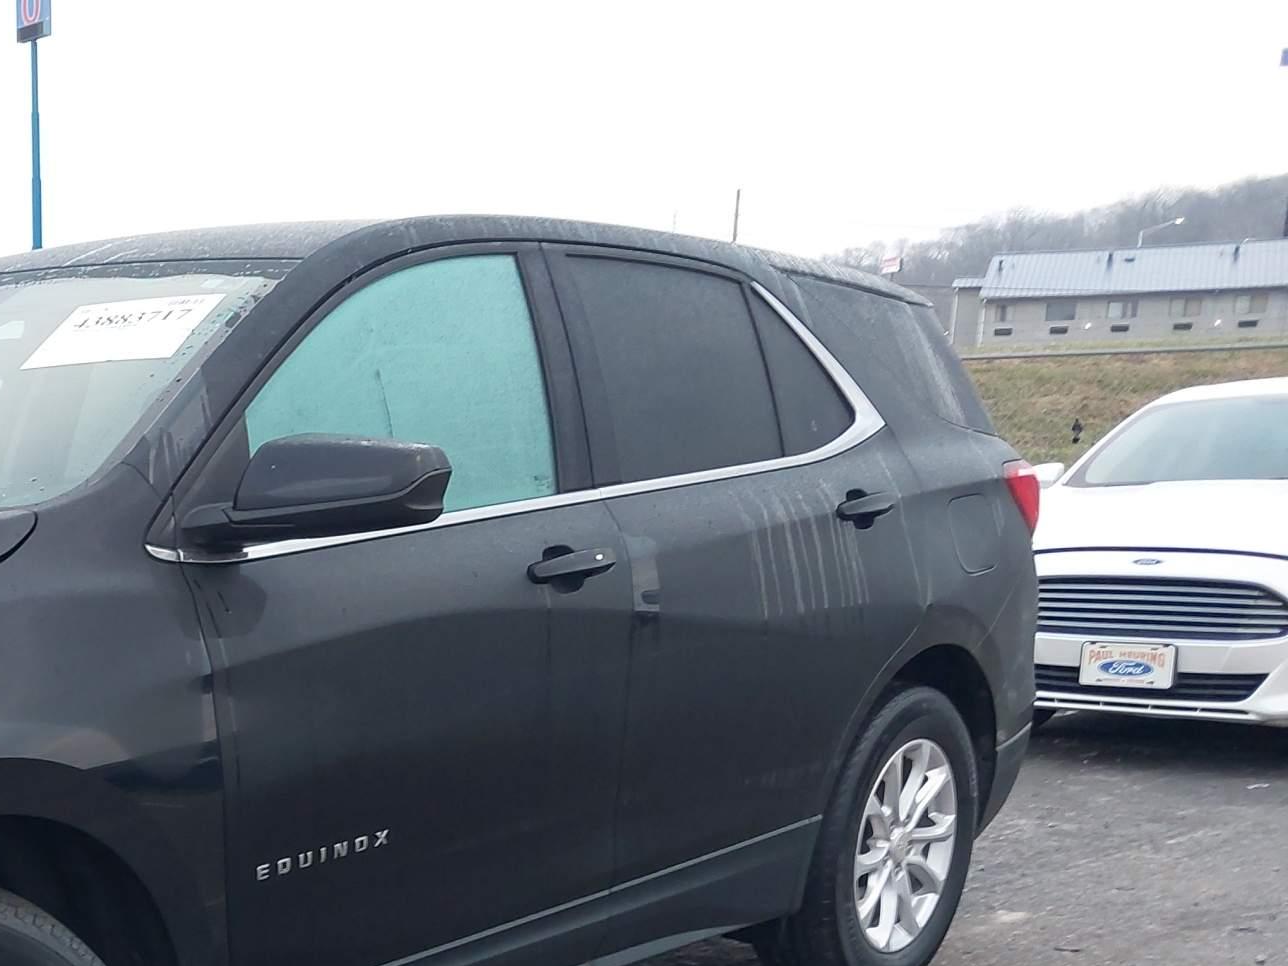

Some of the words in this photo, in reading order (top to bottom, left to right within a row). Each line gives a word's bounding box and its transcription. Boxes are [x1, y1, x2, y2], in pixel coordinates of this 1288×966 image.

[72, 308, 193, 329] 43883717
[1088, 649, 1113, 665] PAUL
[256, 829, 390, 881] EQUINOX
